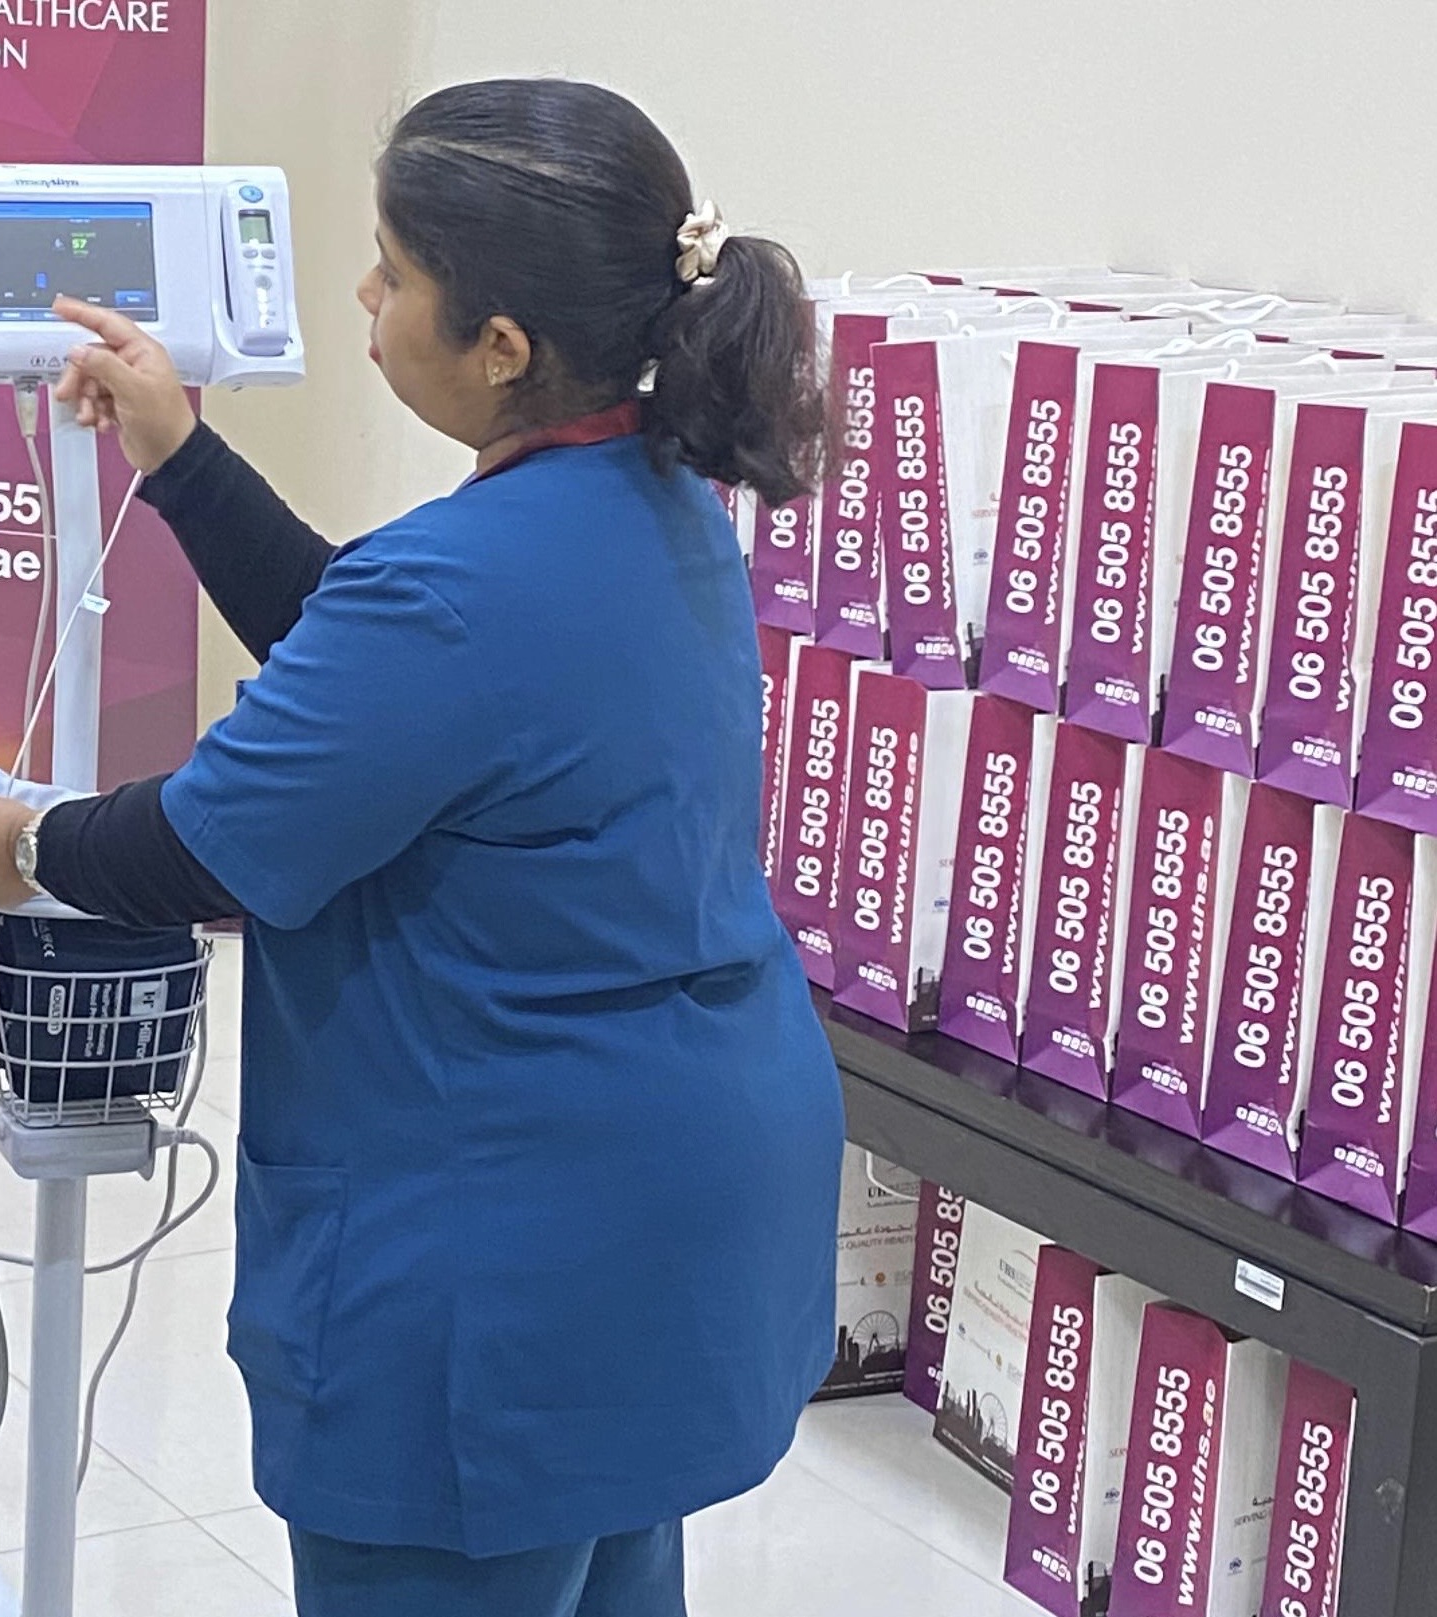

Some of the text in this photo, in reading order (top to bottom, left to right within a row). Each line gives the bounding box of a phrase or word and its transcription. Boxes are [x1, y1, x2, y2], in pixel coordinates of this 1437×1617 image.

[770, 508, 798, 548] 06
[835, 367, 876, 570] 06 505 8555
[894, 395, 932, 605] 06 505 8555
[1005, 398, 1062, 614] 06 505 8555
[1091, 422, 1142, 644] 06 505 8555
[1209, 444, 1253, 538] 8555
[1192, 623, 1227, 672] 06
[1199, 545, 1239, 616] 505
[1288, 466, 1348, 700] 06 505 8555
[1396, 596, 1437, 671] 505
[795, 698, 841, 897] 06 505 8555
[978, 752, 1017, 838] 8555
[1388, 679, 1427, 730] 06
[854, 726, 898, 931] 06 505 8555
[969, 844, 1004, 910] 505
[1049, 781, 1103, 994] 06 505 8555
[1137, 808, 1190, 1028] 06 505 8555
[1179, 815, 1212, 1043] www.uhs.ae
[963, 916, 995, 960] 06
[1234, 845, 1298, 1068] 06 505 8555
[1331, 875, 1395, 1108] 06 505 8555
[135, 1021, 153, 1059] Hillro
[925, 1186, 964, 1334] 06 505 85
[1029, 1304, 1084, 1515] 06 505 8555
[1133, 1366, 1191, 1585] 06 505 8555
[1178, 1378, 1216, 1606] www.uhs.ae
[1280, 1420, 1333, 1617] 6 505 8555
